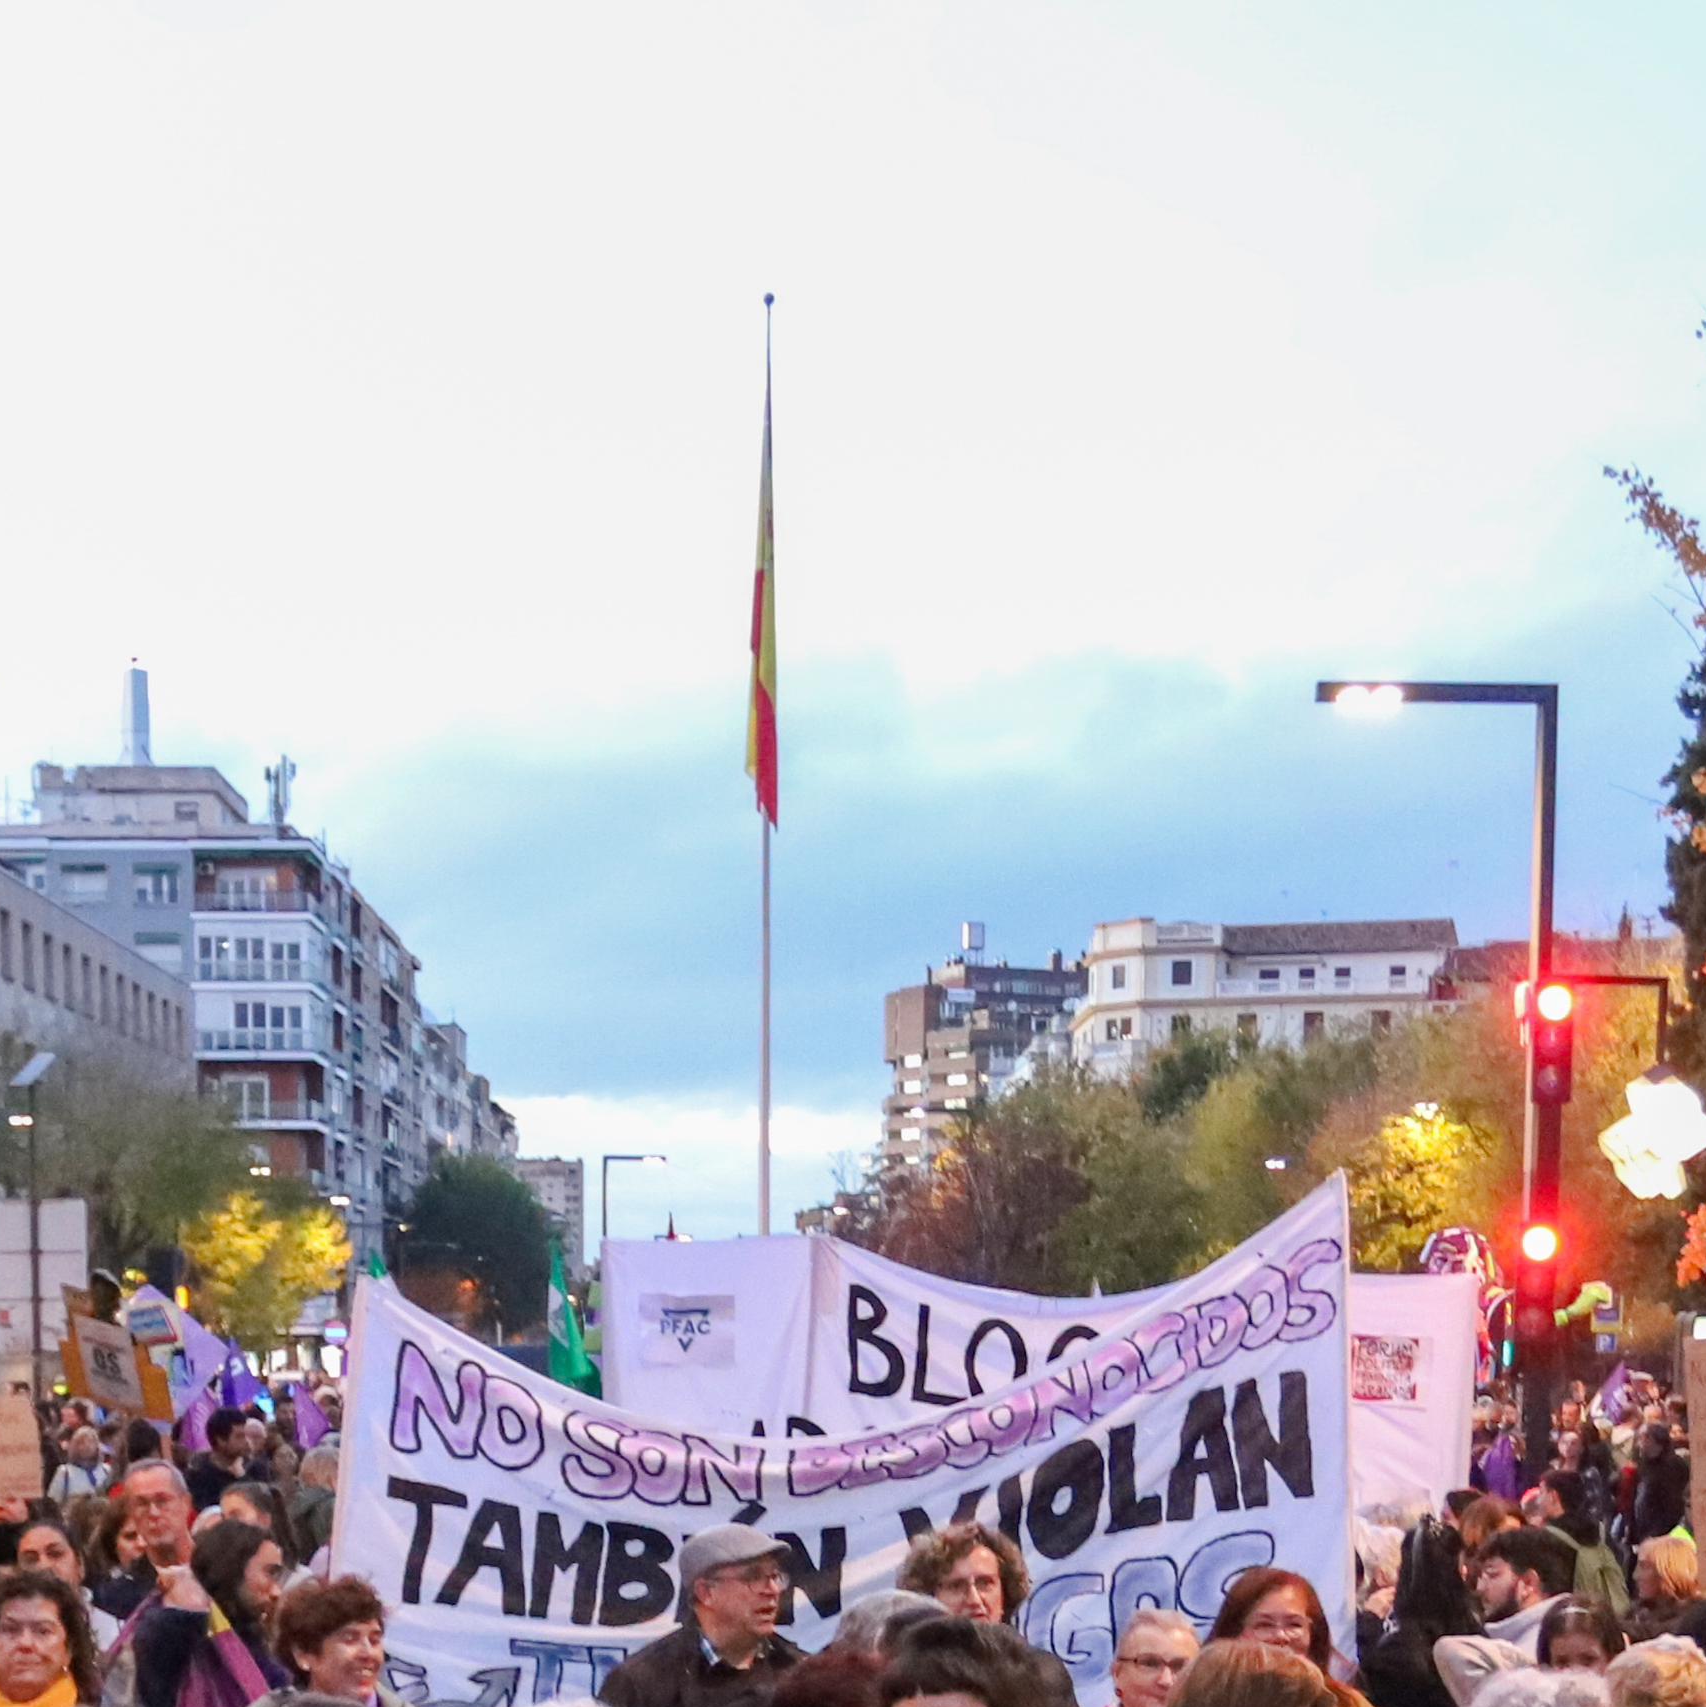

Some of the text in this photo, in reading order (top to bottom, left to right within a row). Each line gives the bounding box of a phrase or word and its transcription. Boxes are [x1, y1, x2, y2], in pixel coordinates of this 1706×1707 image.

[660, 1318, 711, 1335] PFAC
[391, 1340, 545, 1471] NO
[561, 1409, 764, 1506] SON
[388, 1475, 847, 1627] TAMBN
